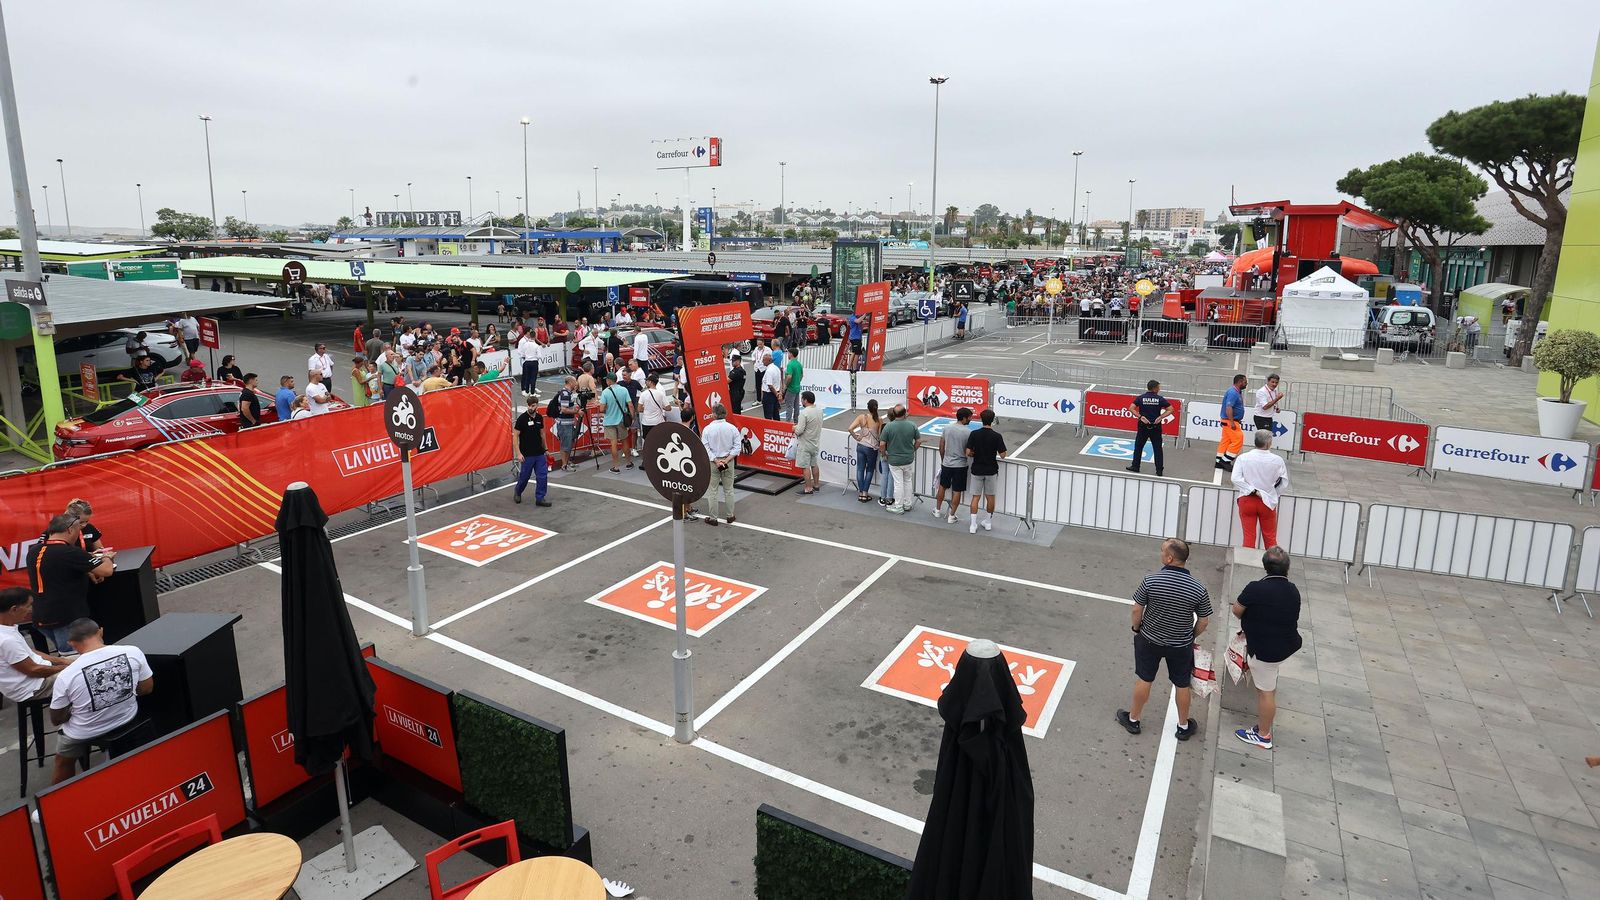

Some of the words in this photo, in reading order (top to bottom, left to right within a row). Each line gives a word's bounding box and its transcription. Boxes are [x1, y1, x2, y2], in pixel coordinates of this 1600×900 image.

[656, 150, 688, 159] Carrefour
[416, 212, 460, 226] PEPE
[13, 286, 28, 299] salida
[592, 300, 620, 309] POLICA
[694, 354, 717, 366] TISSOT
[866, 387, 907, 395] Carrefour
[951, 388, 983, 398] SOMOS
[950, 396, 984, 405] EQUIPO
[997, 395, 1049, 410] Carrefour
[1089, 404, 1138, 419] Carrefo
[1192, 415, 1255, 432] Carrur
[394, 431, 414, 442] motos
[763, 433, 791, 445] SOMO
[1308, 427, 1381, 446] Carrefour
[763, 442, 788, 454] EQUI
[1442, 443, 1530, 465] Carrefour
[343, 450, 363, 470] LA
[362, 442, 399, 465] VUEL
[820, 450, 857, 466] Carrefo
[662, 479, 694, 493] motos
[389, 710, 399, 724] LA
[398, 715, 425, 737] VUELTA
[427, 728, 438, 743] 24
[97, 822, 120, 843] LA
[120, 792, 179, 830] VUELTA
[187, 777, 206, 797] 24
